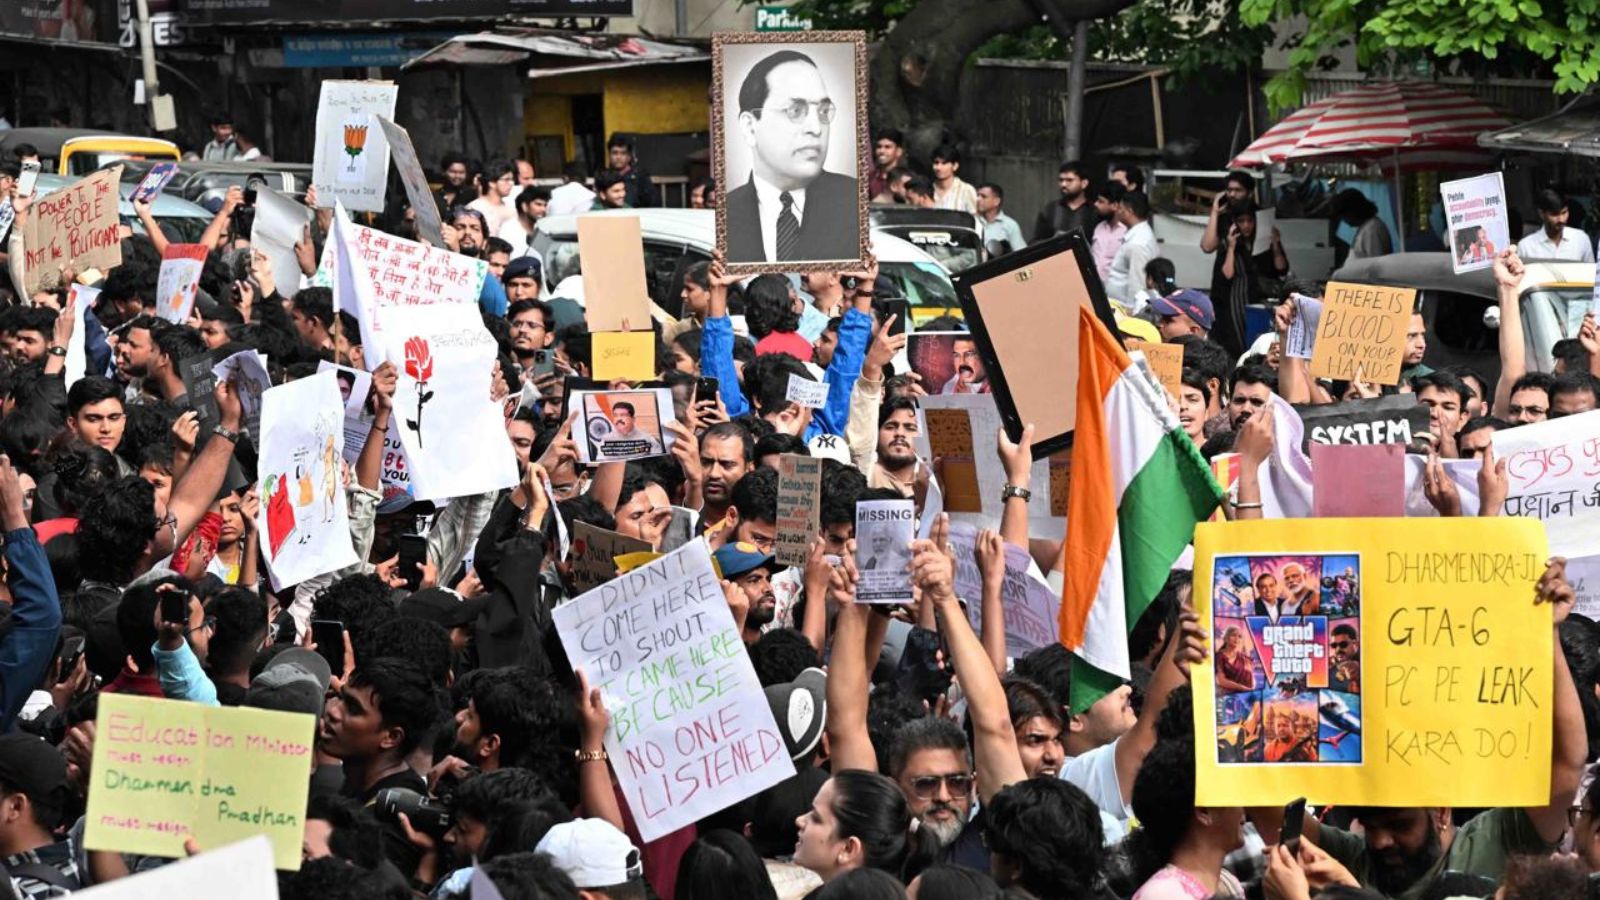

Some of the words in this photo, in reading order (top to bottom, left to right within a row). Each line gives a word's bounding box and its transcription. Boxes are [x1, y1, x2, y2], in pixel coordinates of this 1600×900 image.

[51, 197, 103, 232] PEOPLE
[26, 247, 45, 270] NOT
[1335, 288, 1382, 309] THERE
[1388, 292, 1405, 314] IS
[1322, 310, 1394, 344] BLOOD
[1338, 342, 1360, 357] ON
[1363, 345, 1396, 360] YOUR
[1311, 418, 1412, 446] SYSTEM
[858, 508, 912, 522] MISSING
[1386, 551, 1538, 587] DHARMENDRA-JI
[581, 602, 649, 653] COME
[653, 573, 716, 620] HERE
[1387, 606, 1490, 647] GTA-6
[591, 650, 622, 678] TO
[626, 653, 686, 698] CAME
[690, 628, 741, 668] HERE
[1271, 657, 1312, 673] auto
[1385, 665, 1418, 708] PC
[1434, 666, 1461, 703] PE
[1477, 666, 1539, 708] LEAK
[625, 740, 665, 780] NO
[674, 703, 742, 757] ONE
[1386, 728, 1463, 767] KARA
